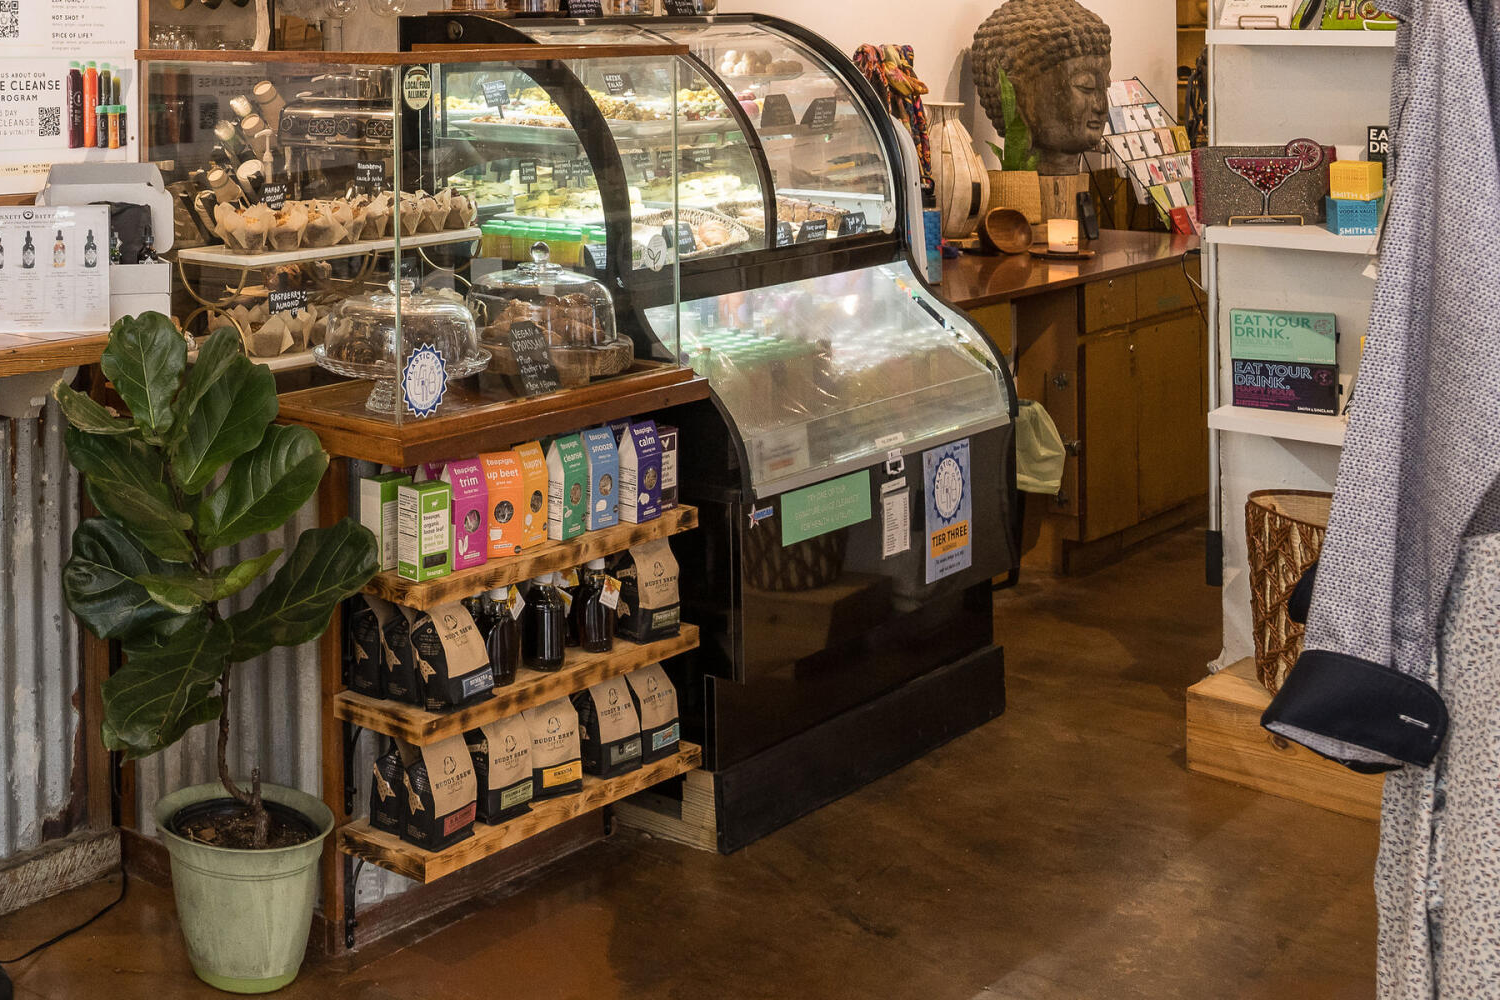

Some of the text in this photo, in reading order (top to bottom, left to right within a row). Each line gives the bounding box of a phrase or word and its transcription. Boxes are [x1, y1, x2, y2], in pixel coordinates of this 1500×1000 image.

[10, 80, 61, 91] CLEANSE
[406, 79, 430, 90] LOCAL FOOD
[408, 88, 428, 99] ALLIANCE
[270, 291, 301, 302] RASPBERRY
[276, 302, 299, 310] ALMOND
[1234, 314, 1312, 328] EAT YOUR
[512, 328, 534, 339] VEGAN
[1234, 326, 1290, 340] DRINK.
[408, 352, 430, 380] PLASTIC
[1234, 362, 1312, 380] EAT YOUR
[1234, 374, 1290, 389] DRINK.
[1236, 385, 1296, 396] HAPPY HOUR
[634, 426, 654, 434] teapigs.
[589, 432, 610, 442] teapigs.
[639, 436, 656, 448] calm
[560, 440, 580, 450] teapigs.
[592, 443, 614, 453] snooze
[486, 458, 515, 466] teapigs.
[524, 457, 543, 469] happy
[564, 452, 582, 463] cleanse
[454, 465, 479, 476] teapigs.
[487, 468, 518, 480] up beet
[460, 476, 478, 488] trim
[932, 524, 968, 548] TIER THREE
[534, 731, 575, 744] BUDDY BREW
[435, 770, 472, 790] BUDDY BREW
